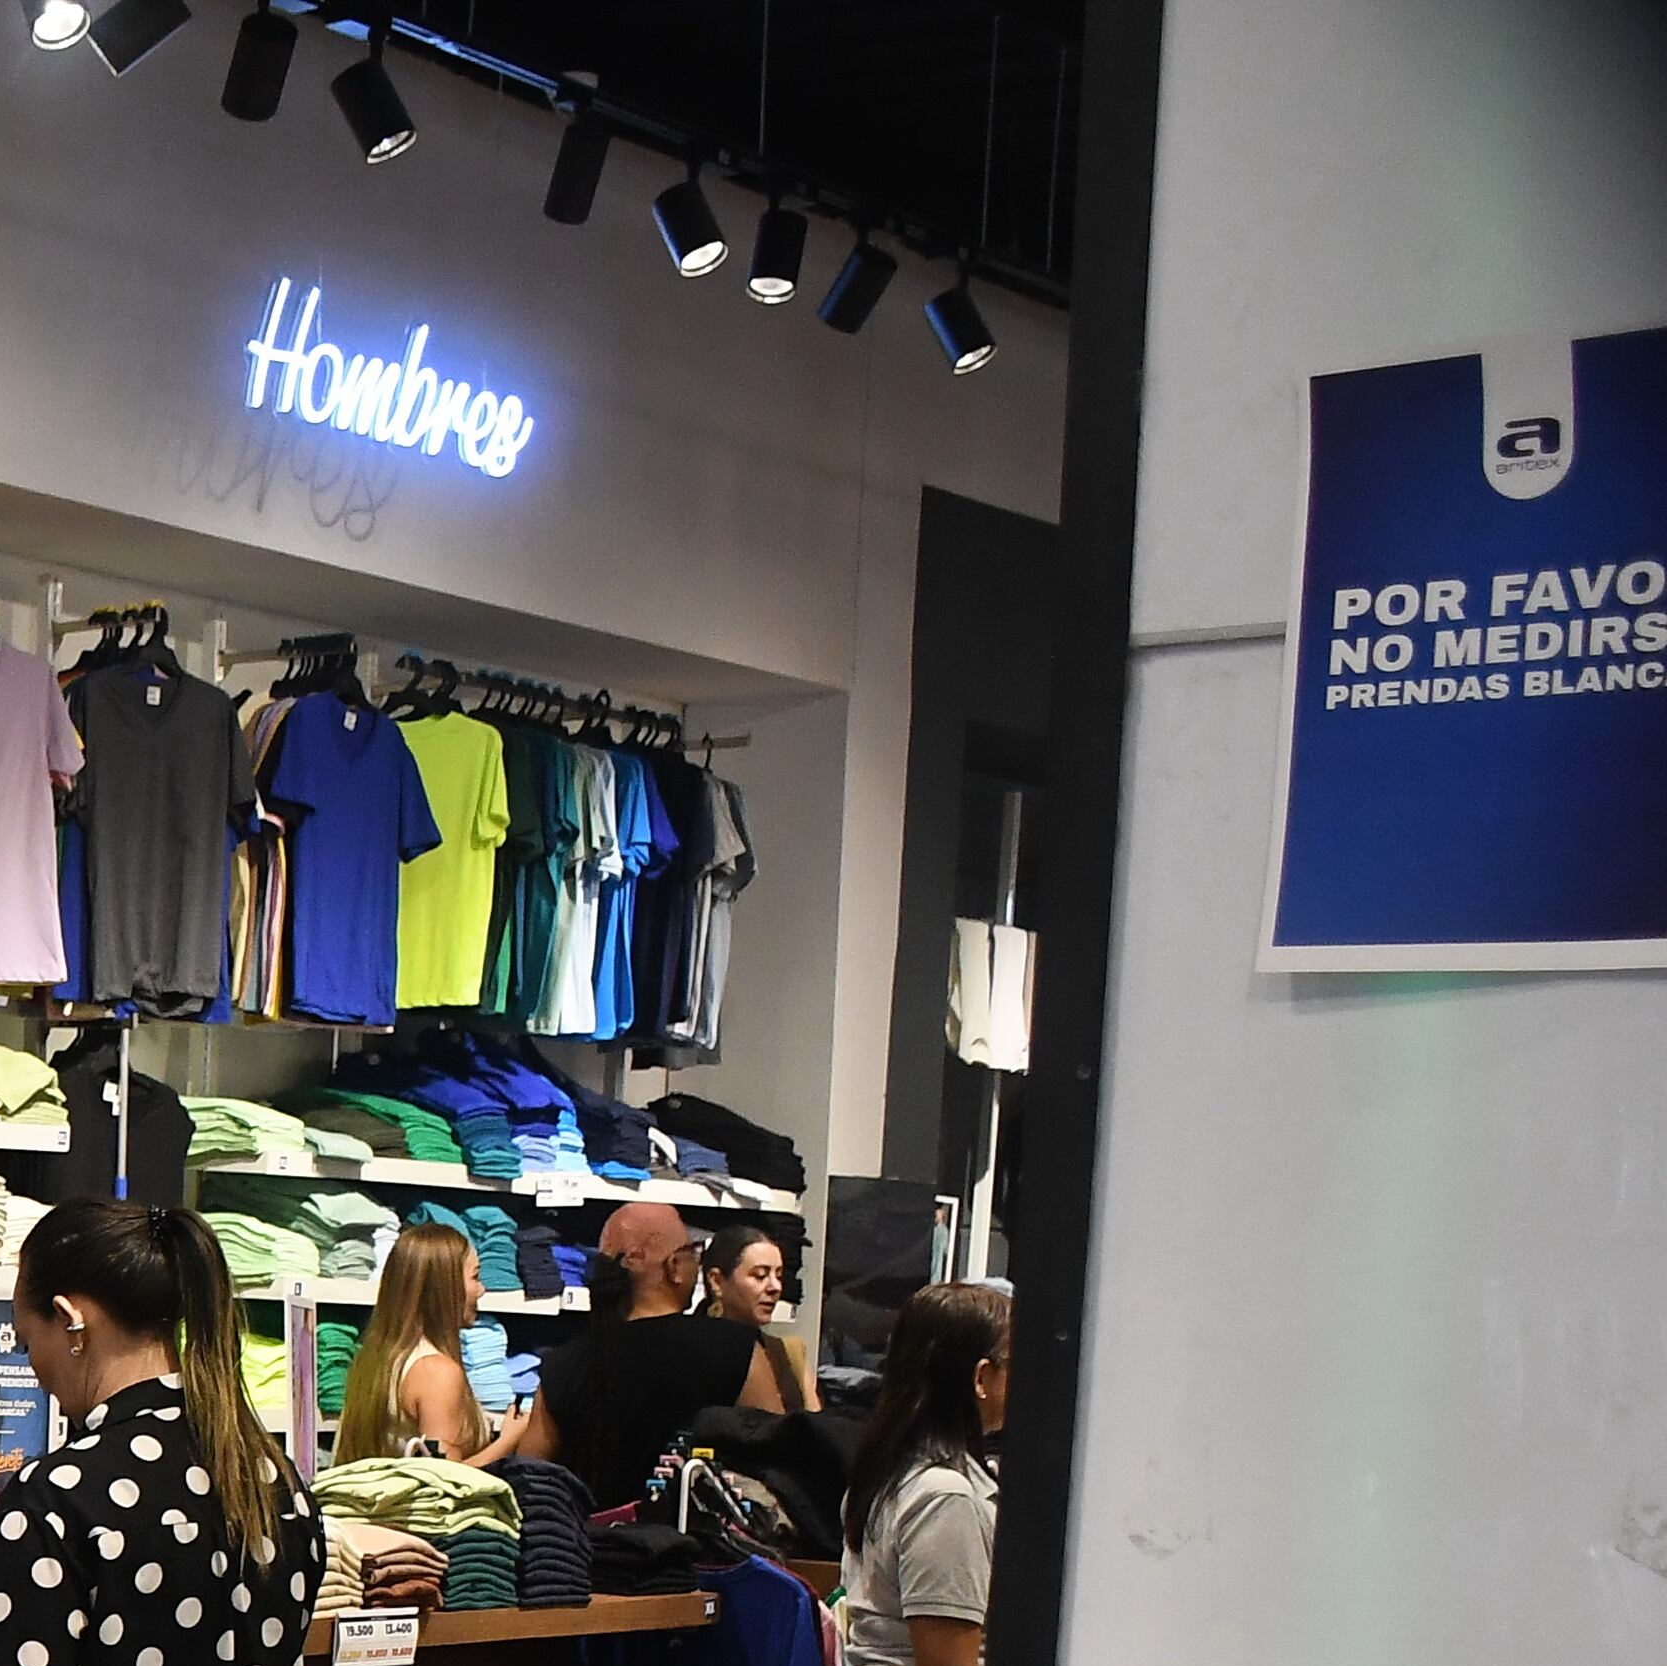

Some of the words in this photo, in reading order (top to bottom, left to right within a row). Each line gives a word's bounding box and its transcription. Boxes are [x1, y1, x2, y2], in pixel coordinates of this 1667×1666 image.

[248, 277, 533, 478] Hombres
[1333, 580, 1466, 630] POR
[1329, 634, 1414, 676] NO
[1325, 673, 1510, 711] PRENDAS
[1523, 661, 1667, 697] BLANC
